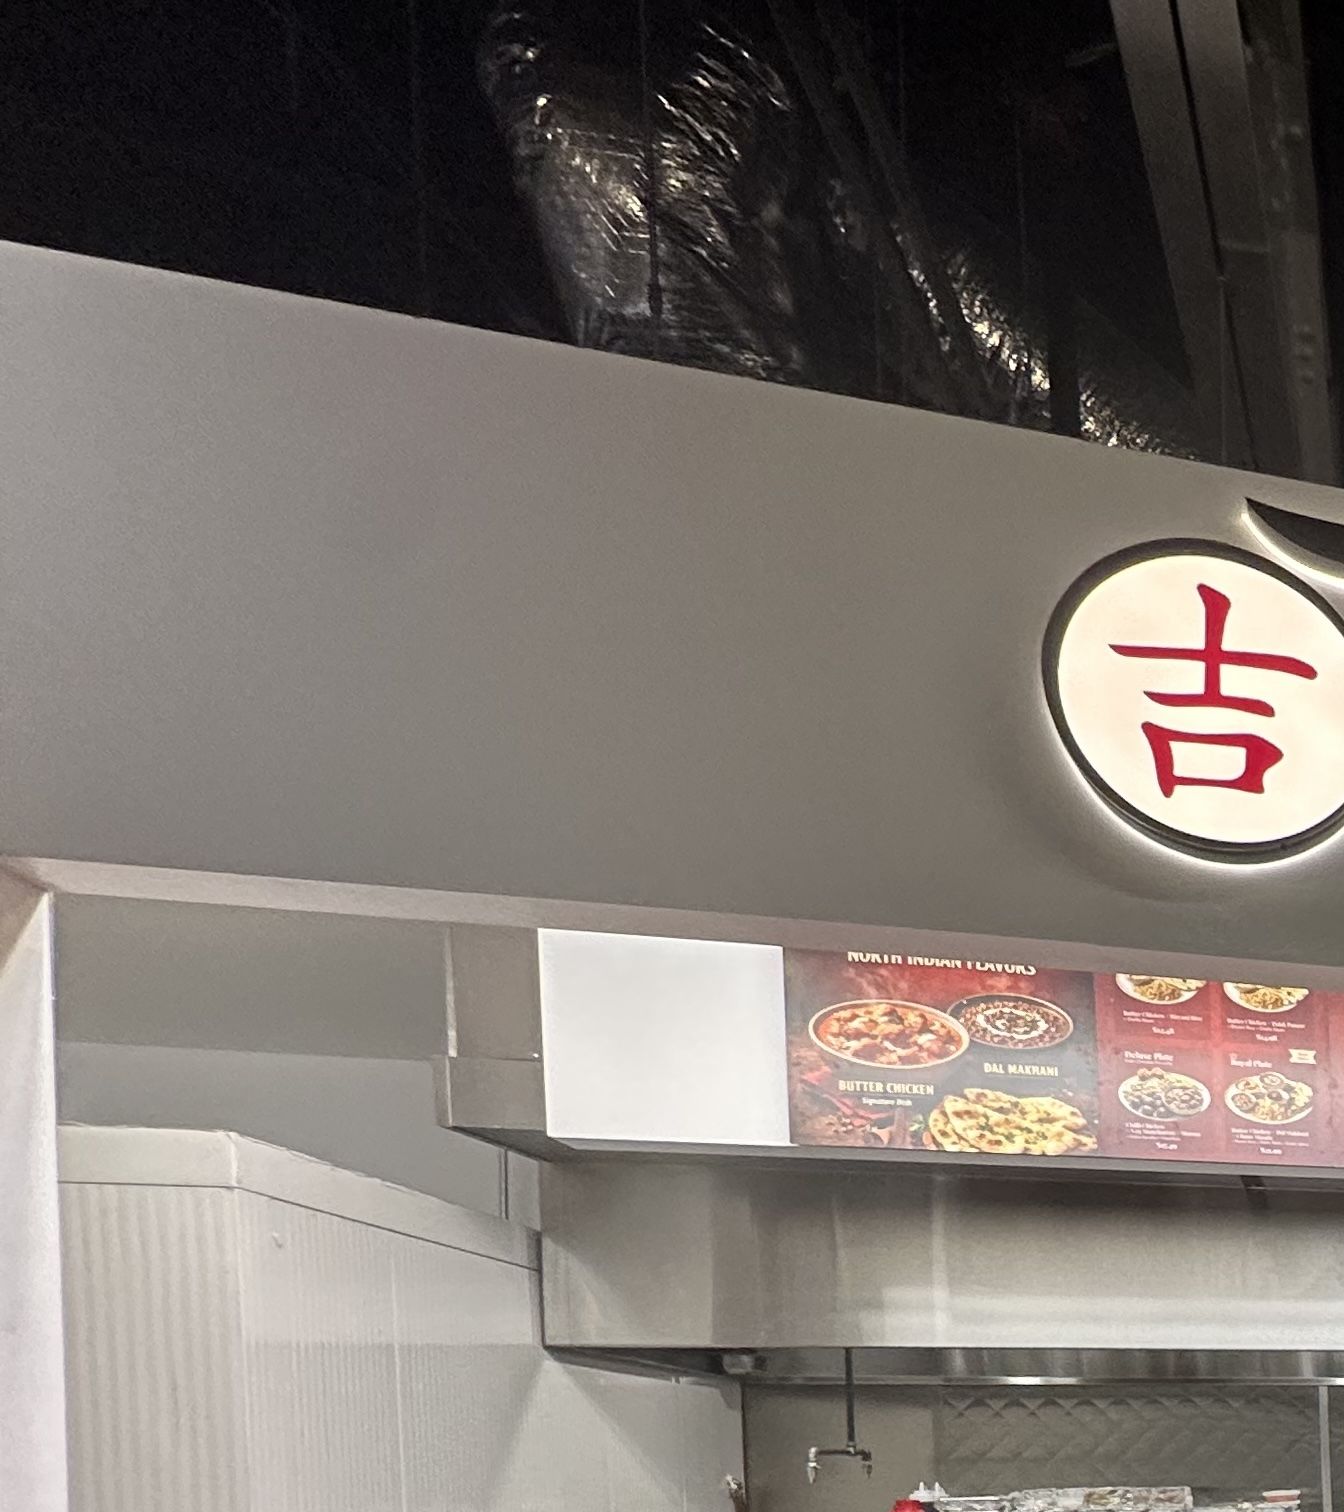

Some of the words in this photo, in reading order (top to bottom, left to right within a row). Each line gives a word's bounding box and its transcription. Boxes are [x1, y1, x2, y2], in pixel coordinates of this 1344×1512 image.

[1108, 583, 1318, 799] 吉
[983, 1062, 1004, 1074] DAL
[1007, 1064, 1059, 1077] MAKHANI
[838, 1079, 884, 1093] BUTTER
[886, 1082, 934, 1096] CHICKEN
